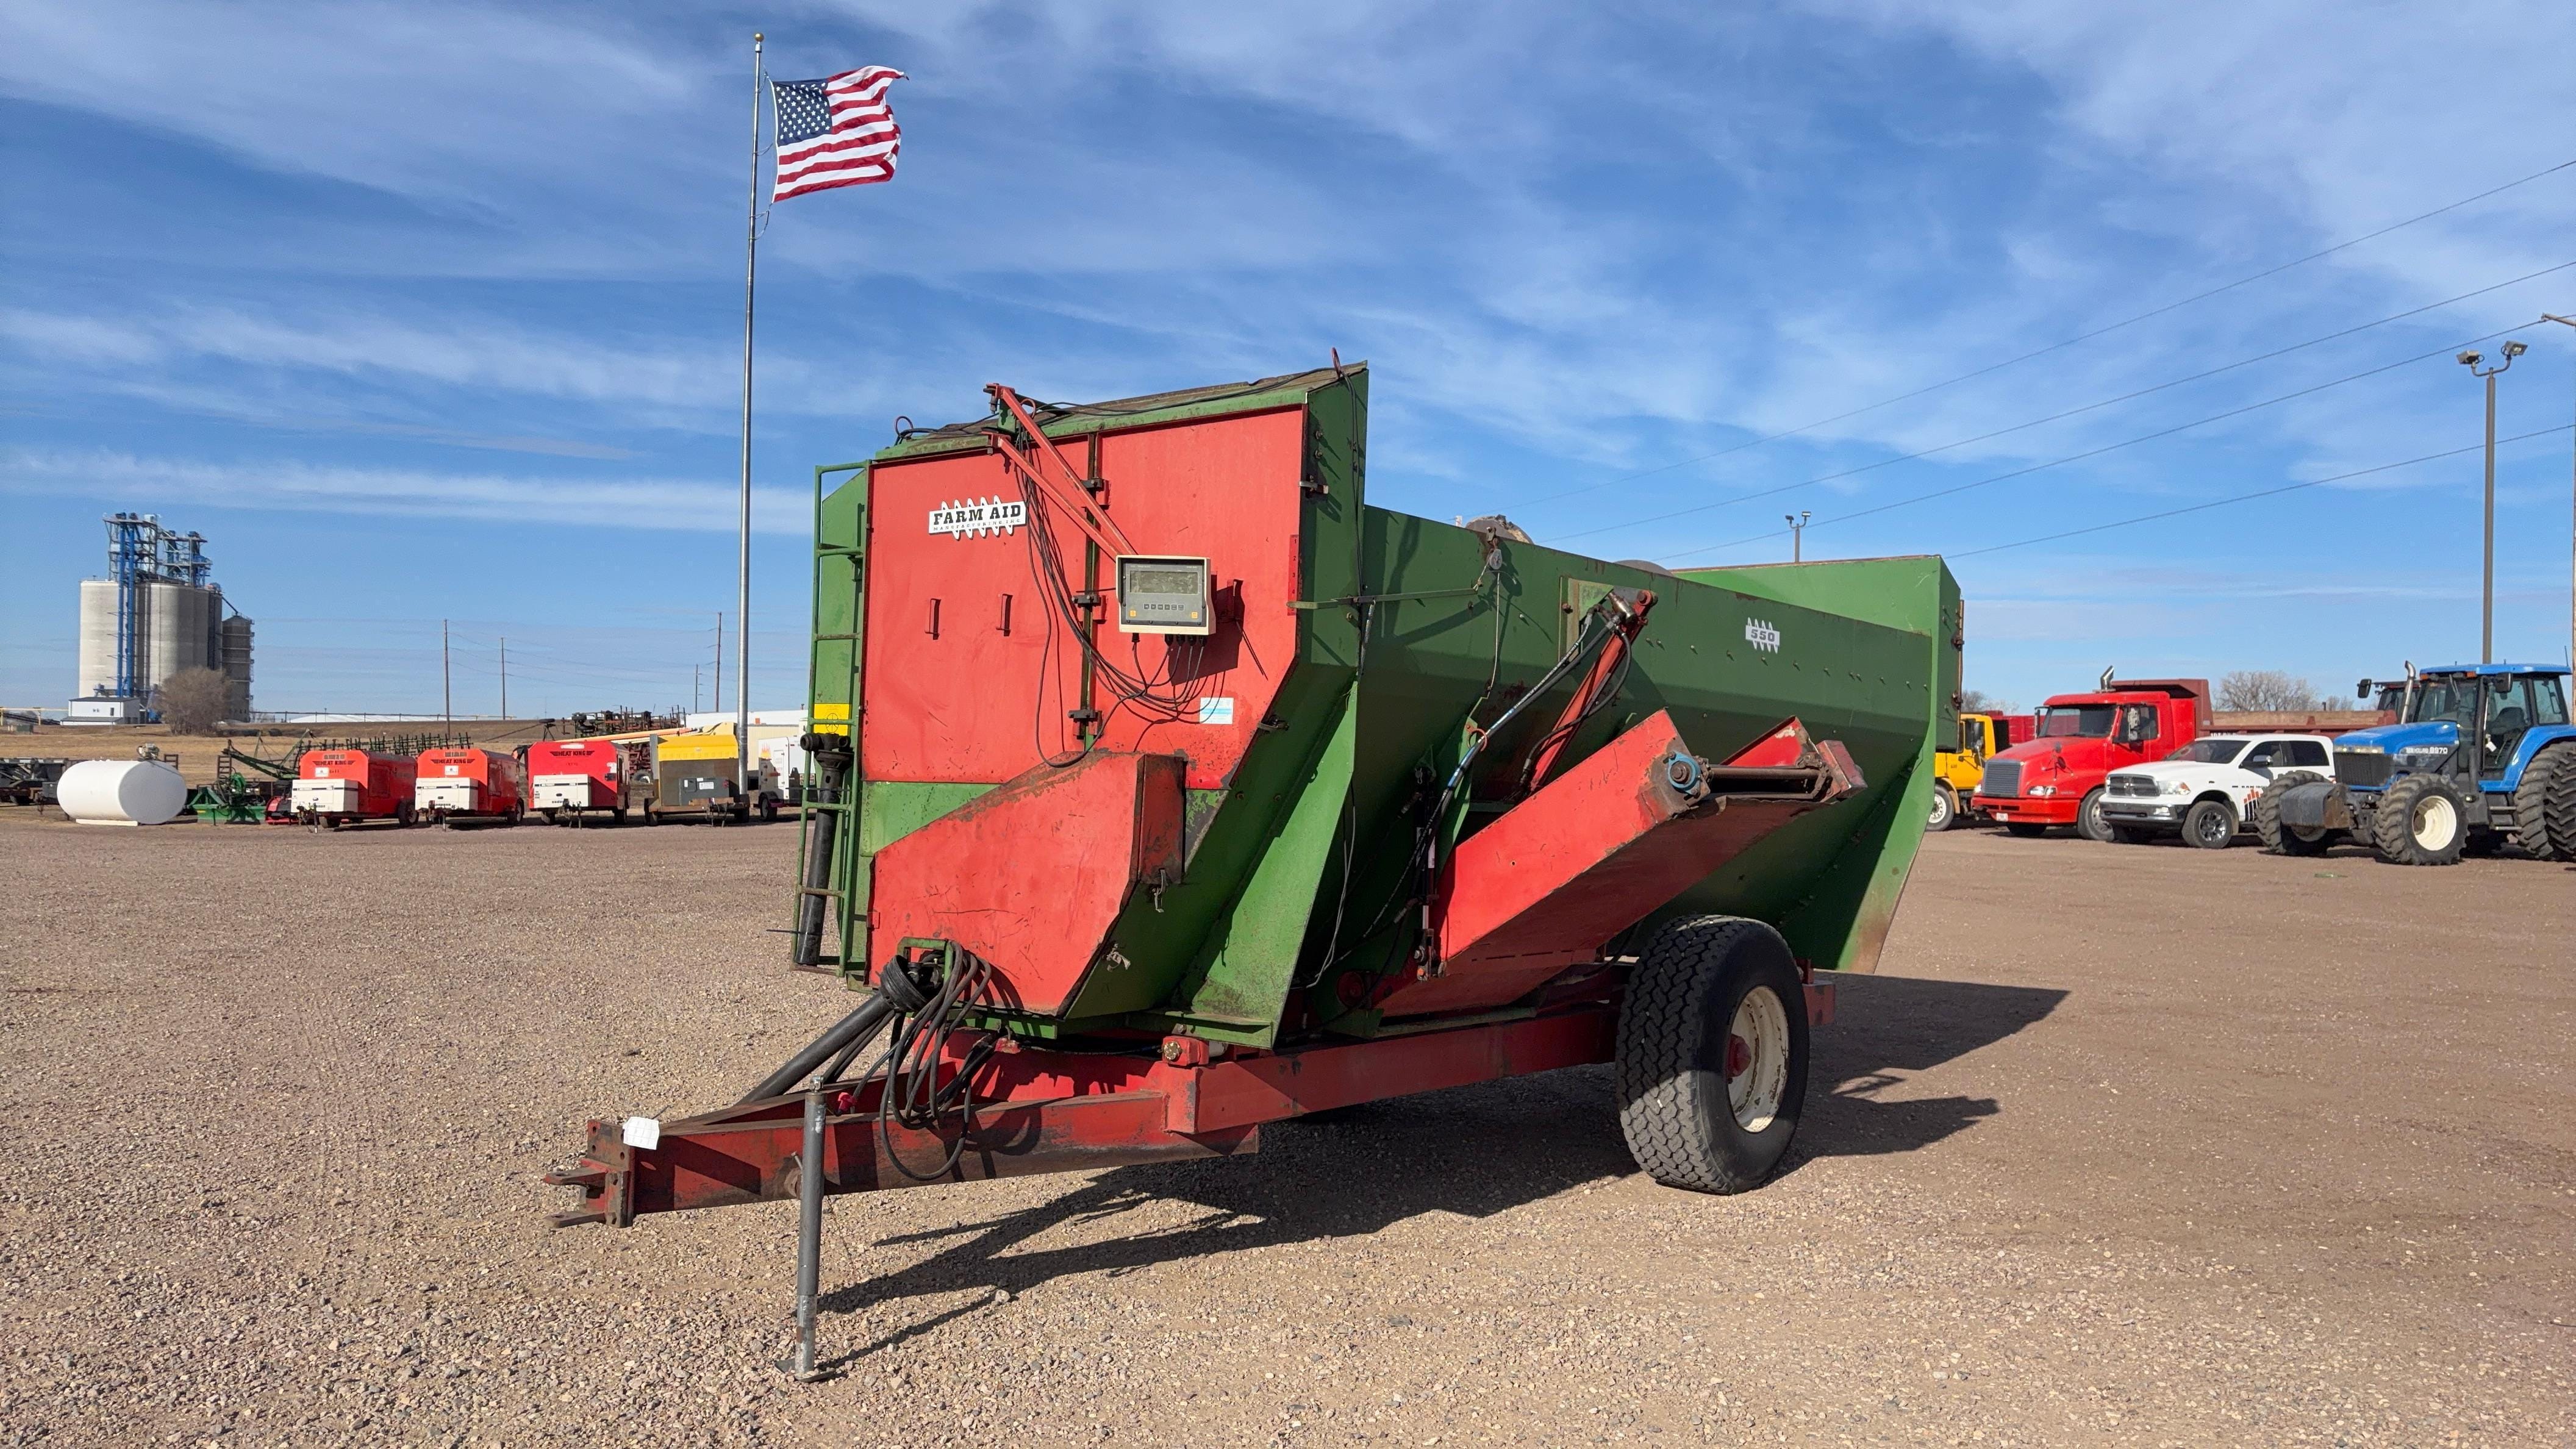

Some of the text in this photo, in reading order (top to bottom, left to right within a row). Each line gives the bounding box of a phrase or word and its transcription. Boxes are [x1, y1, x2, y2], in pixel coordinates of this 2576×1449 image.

[933, 504, 1021, 525] FARM AID
[1750, 628, 1775, 642] 550
